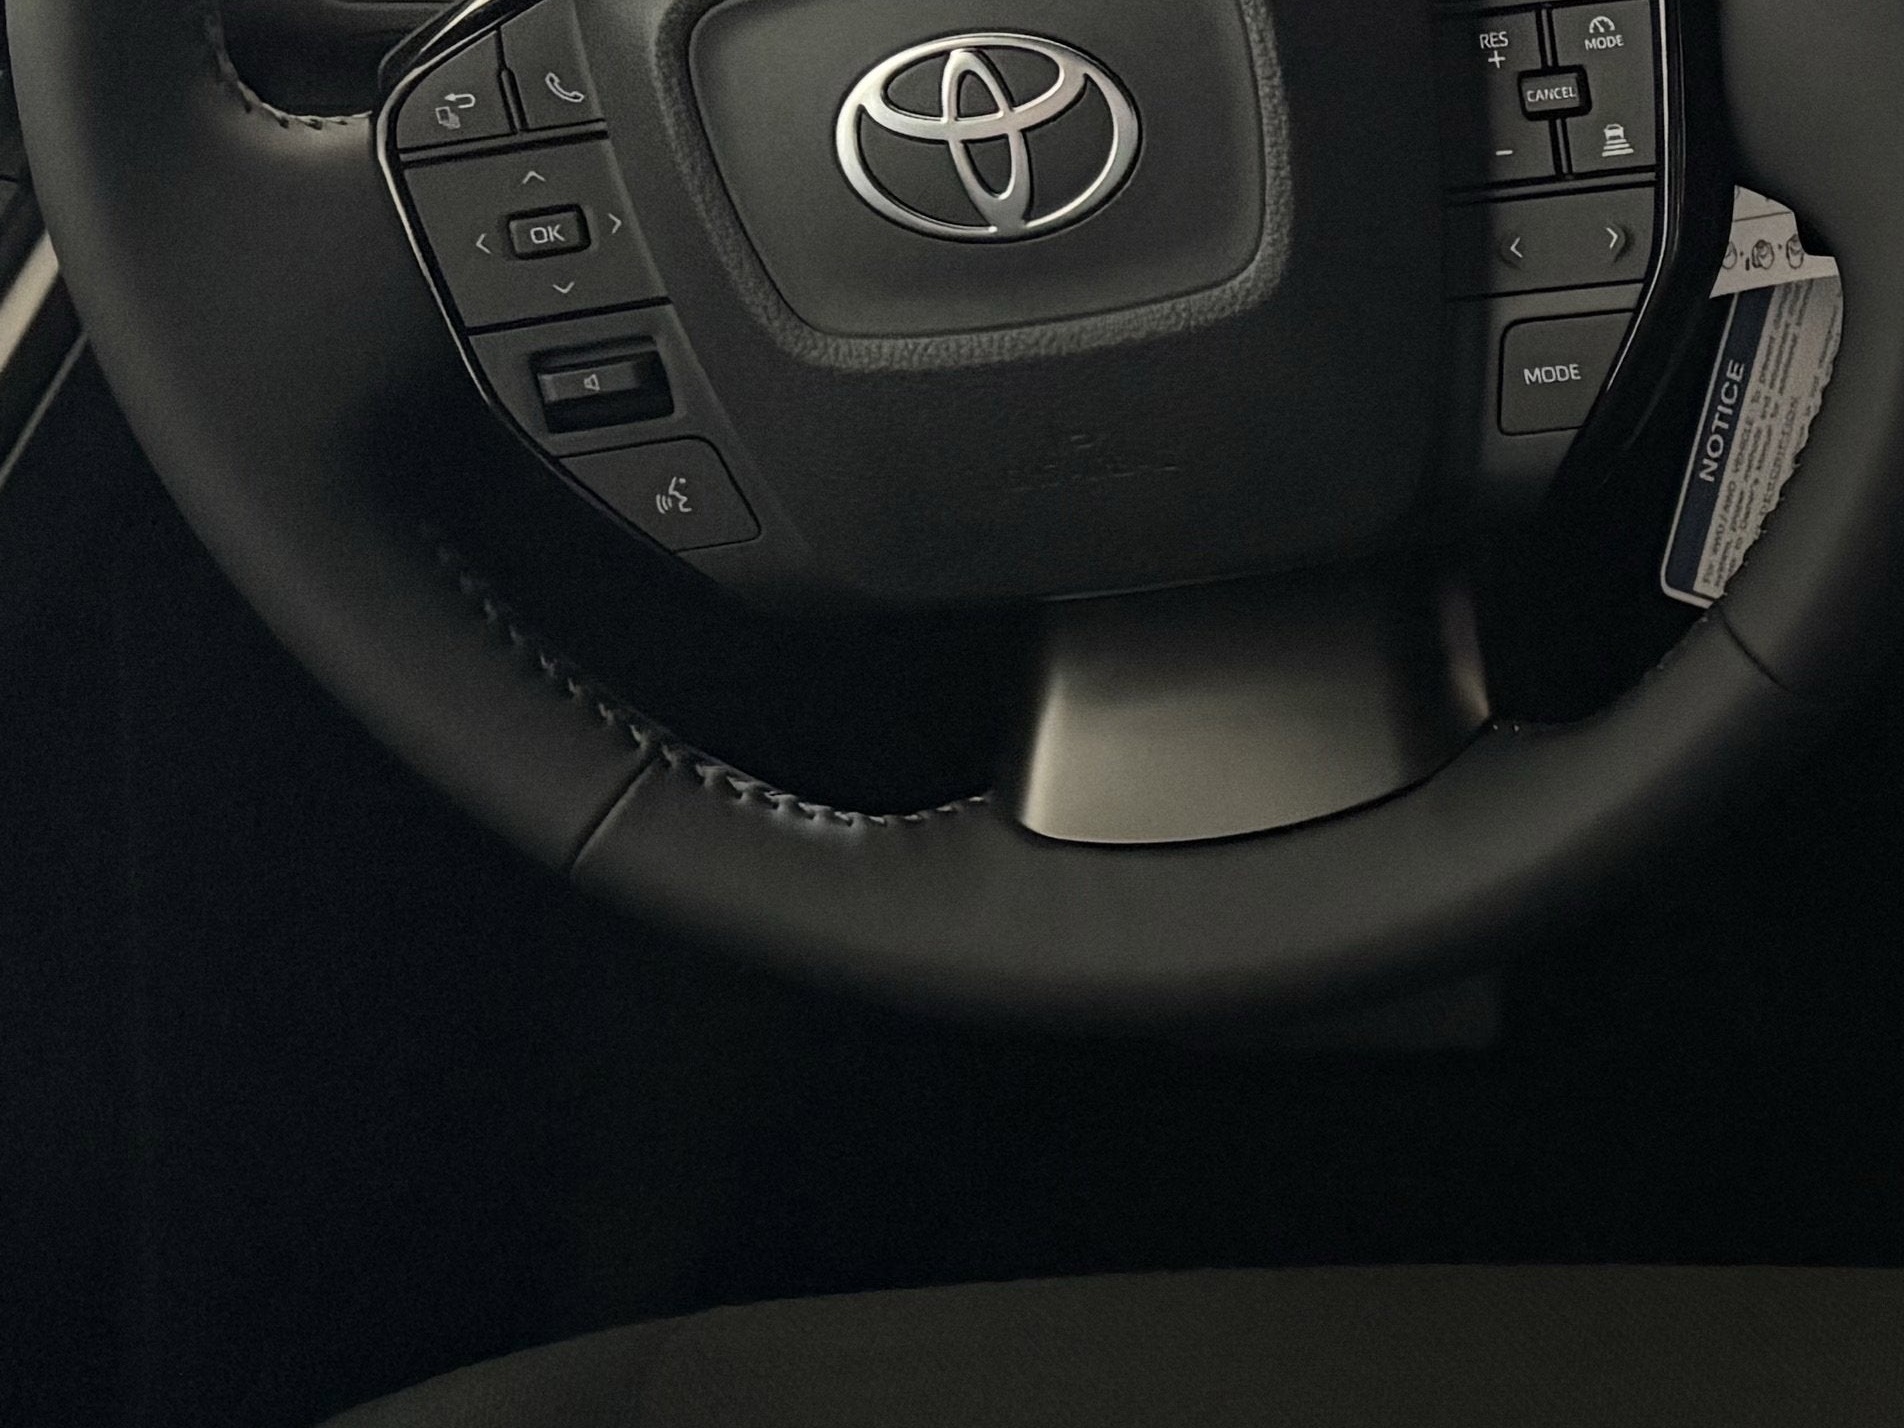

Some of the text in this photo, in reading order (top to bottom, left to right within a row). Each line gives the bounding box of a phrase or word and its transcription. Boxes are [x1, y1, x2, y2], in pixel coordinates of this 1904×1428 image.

[1479, 30, 1509, 49] RES
[1584, 33, 1625, 51] MODE
[1526, 85, 1577, 103] CANCEL
[530, 224, 567, 246] OK
[1523, 362, 1582, 385] MODE
[1699, 357, 1745, 483] NOTICE
